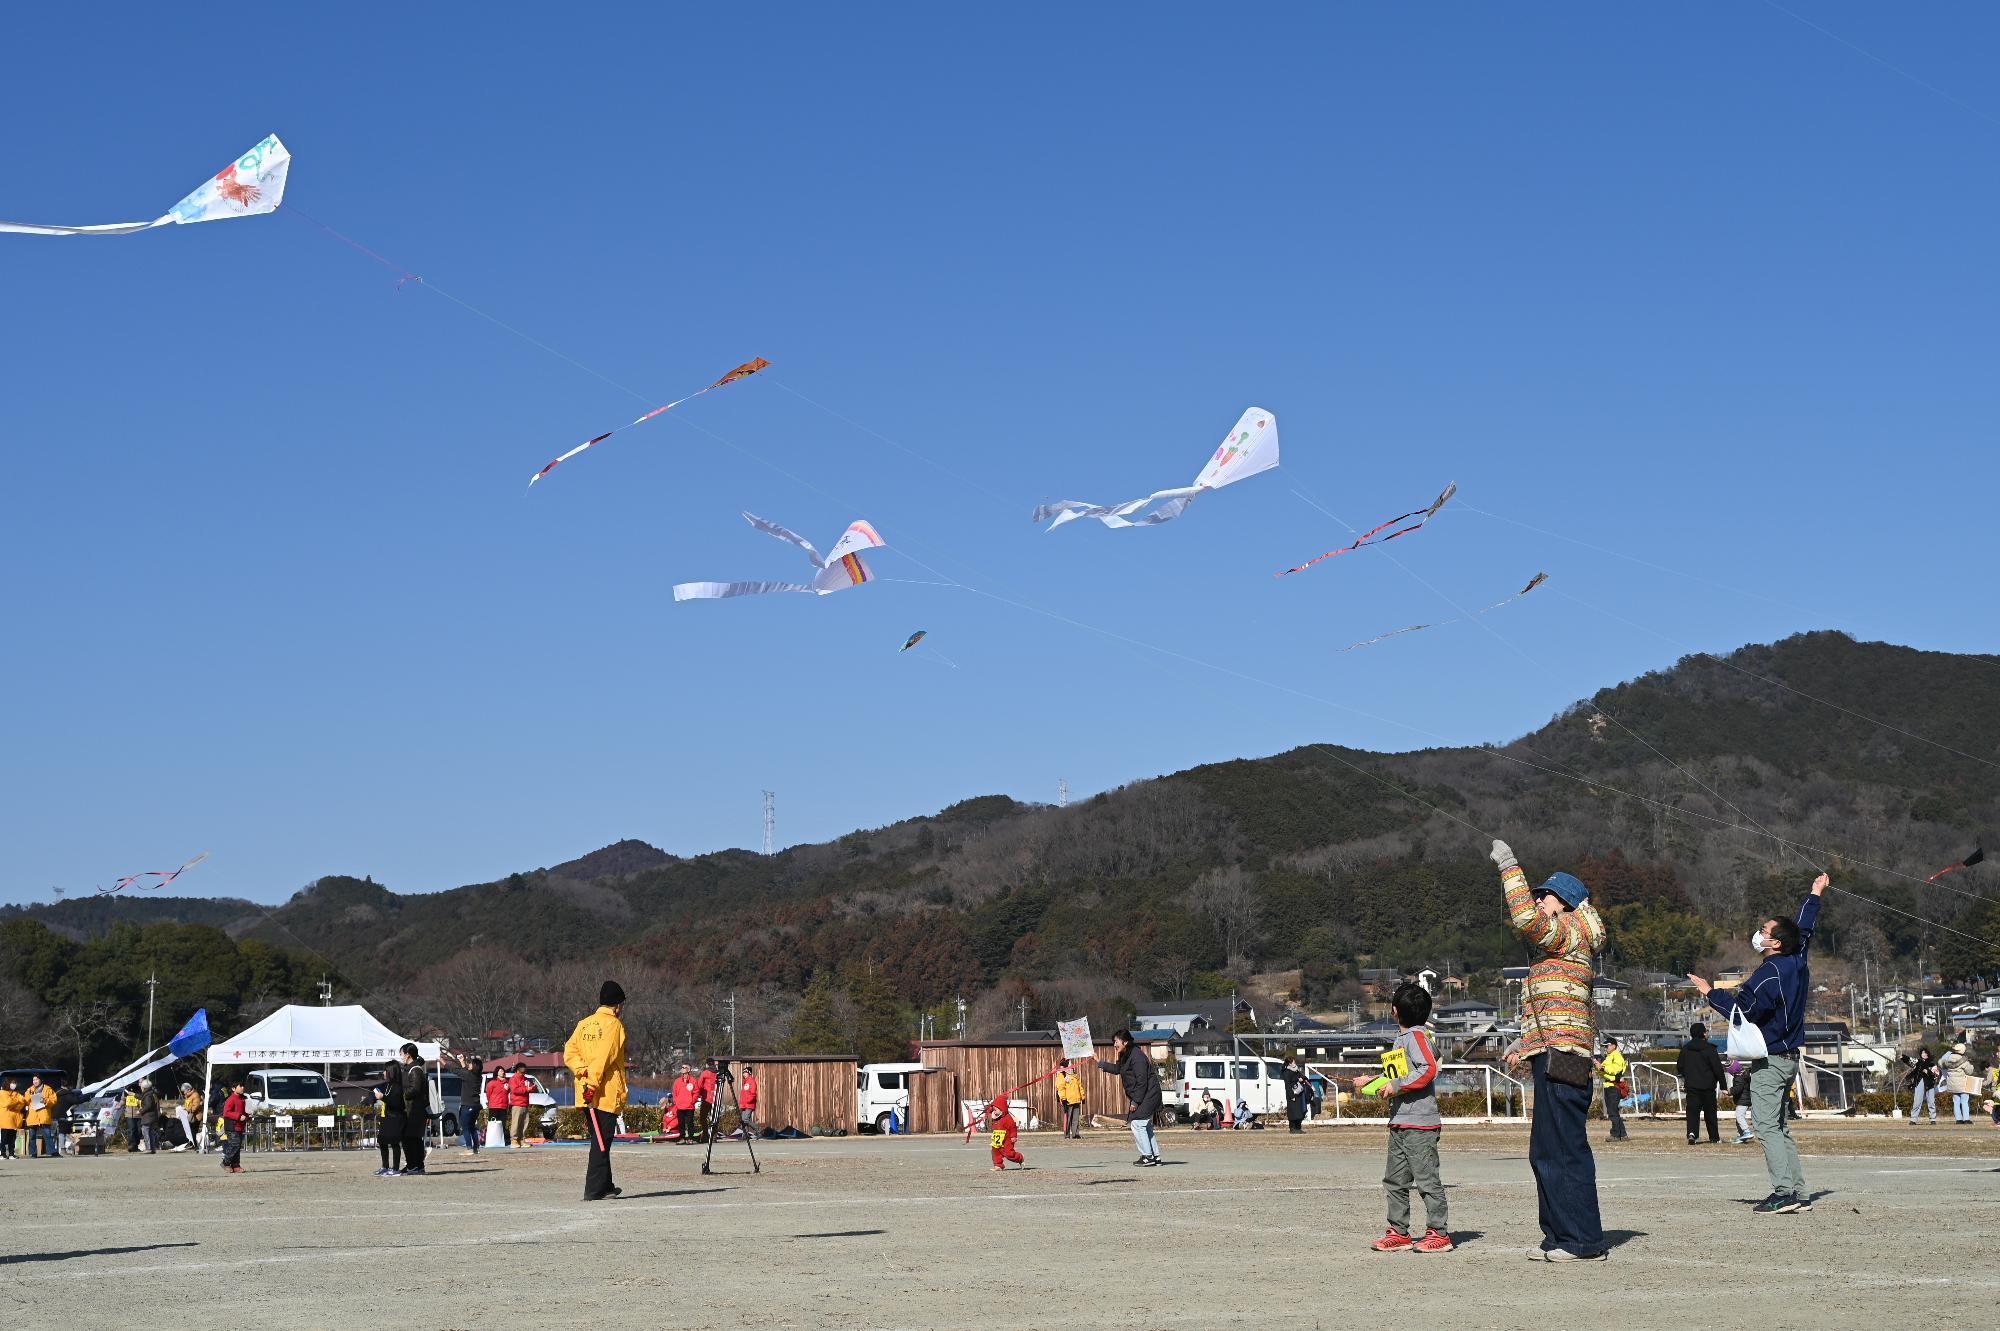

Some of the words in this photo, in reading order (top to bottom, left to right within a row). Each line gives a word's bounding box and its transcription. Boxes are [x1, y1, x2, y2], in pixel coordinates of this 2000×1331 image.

[248, 1049, 400, 1058] 日本赤十字社埼玉県支部日高市
